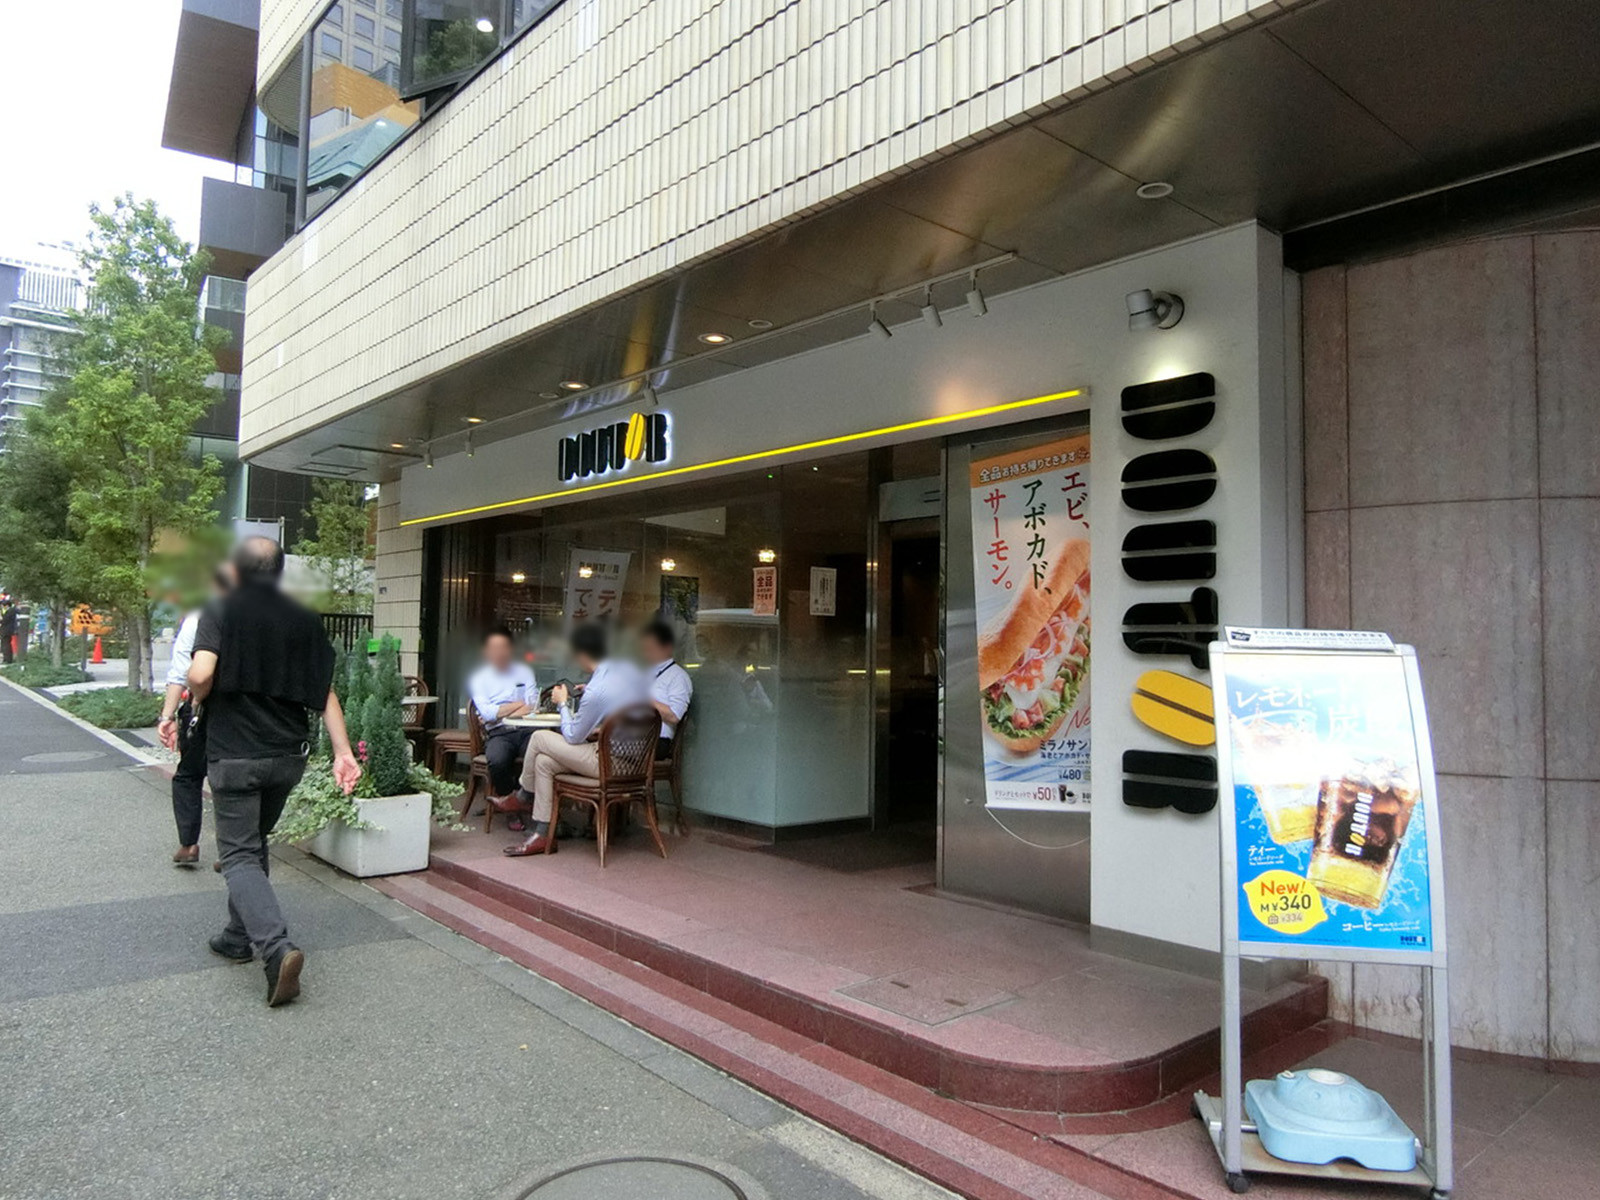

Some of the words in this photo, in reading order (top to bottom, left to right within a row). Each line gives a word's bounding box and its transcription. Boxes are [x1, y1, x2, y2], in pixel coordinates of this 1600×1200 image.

[558, 412, 667, 481] DOUTOR
[979, 451, 1076, 483] 全品お持ち帰りできます
[983, 488, 1013, 590] サーモン。
[1022, 479, 1052, 595] アボカド、
[757, 575, 773, 588] 全品
[1121, 372, 1218, 814] DOUTOR
[1040, 740, 1091, 751] ミラノサン
[1345, 792, 1373, 856] DOUTOR
[1261, 880, 1306, 896] New!
